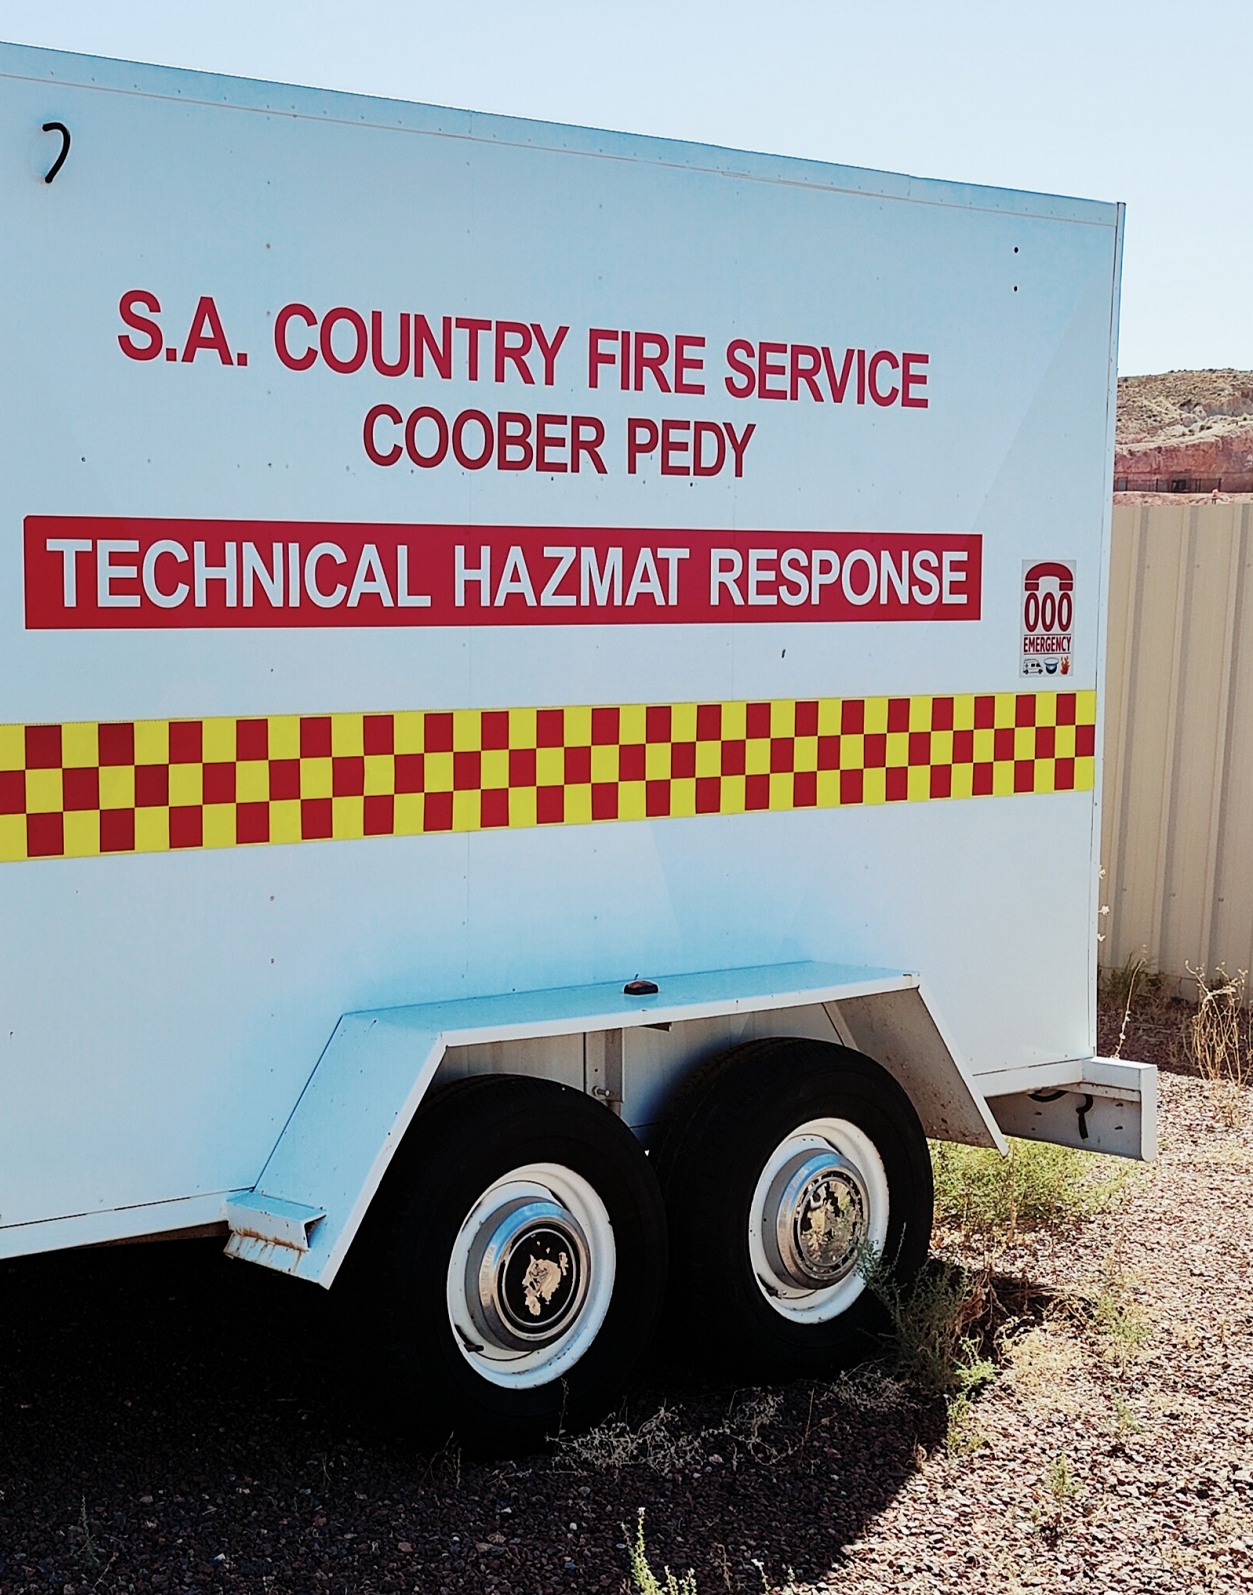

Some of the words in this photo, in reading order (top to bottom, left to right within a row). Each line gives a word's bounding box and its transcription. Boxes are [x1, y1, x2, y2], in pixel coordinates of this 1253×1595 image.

[118, 289, 248, 367] S.A.
[274, 303, 569, 386] COUNTRY
[588, 328, 706, 396] FIRE
[724, 338, 929, 407] SERVICE
[363, 404, 607, 474] COOBER
[627, 417, 755, 478] PEDY
[46, 538, 432, 608] TECHNICAL
[454, 544, 690, 607] HAZMAT
[710, 548, 969, 606] RESPONSE
[1023, 636, 1072, 653] EMERGENCY
[1024, 591, 1073, 633] 000
